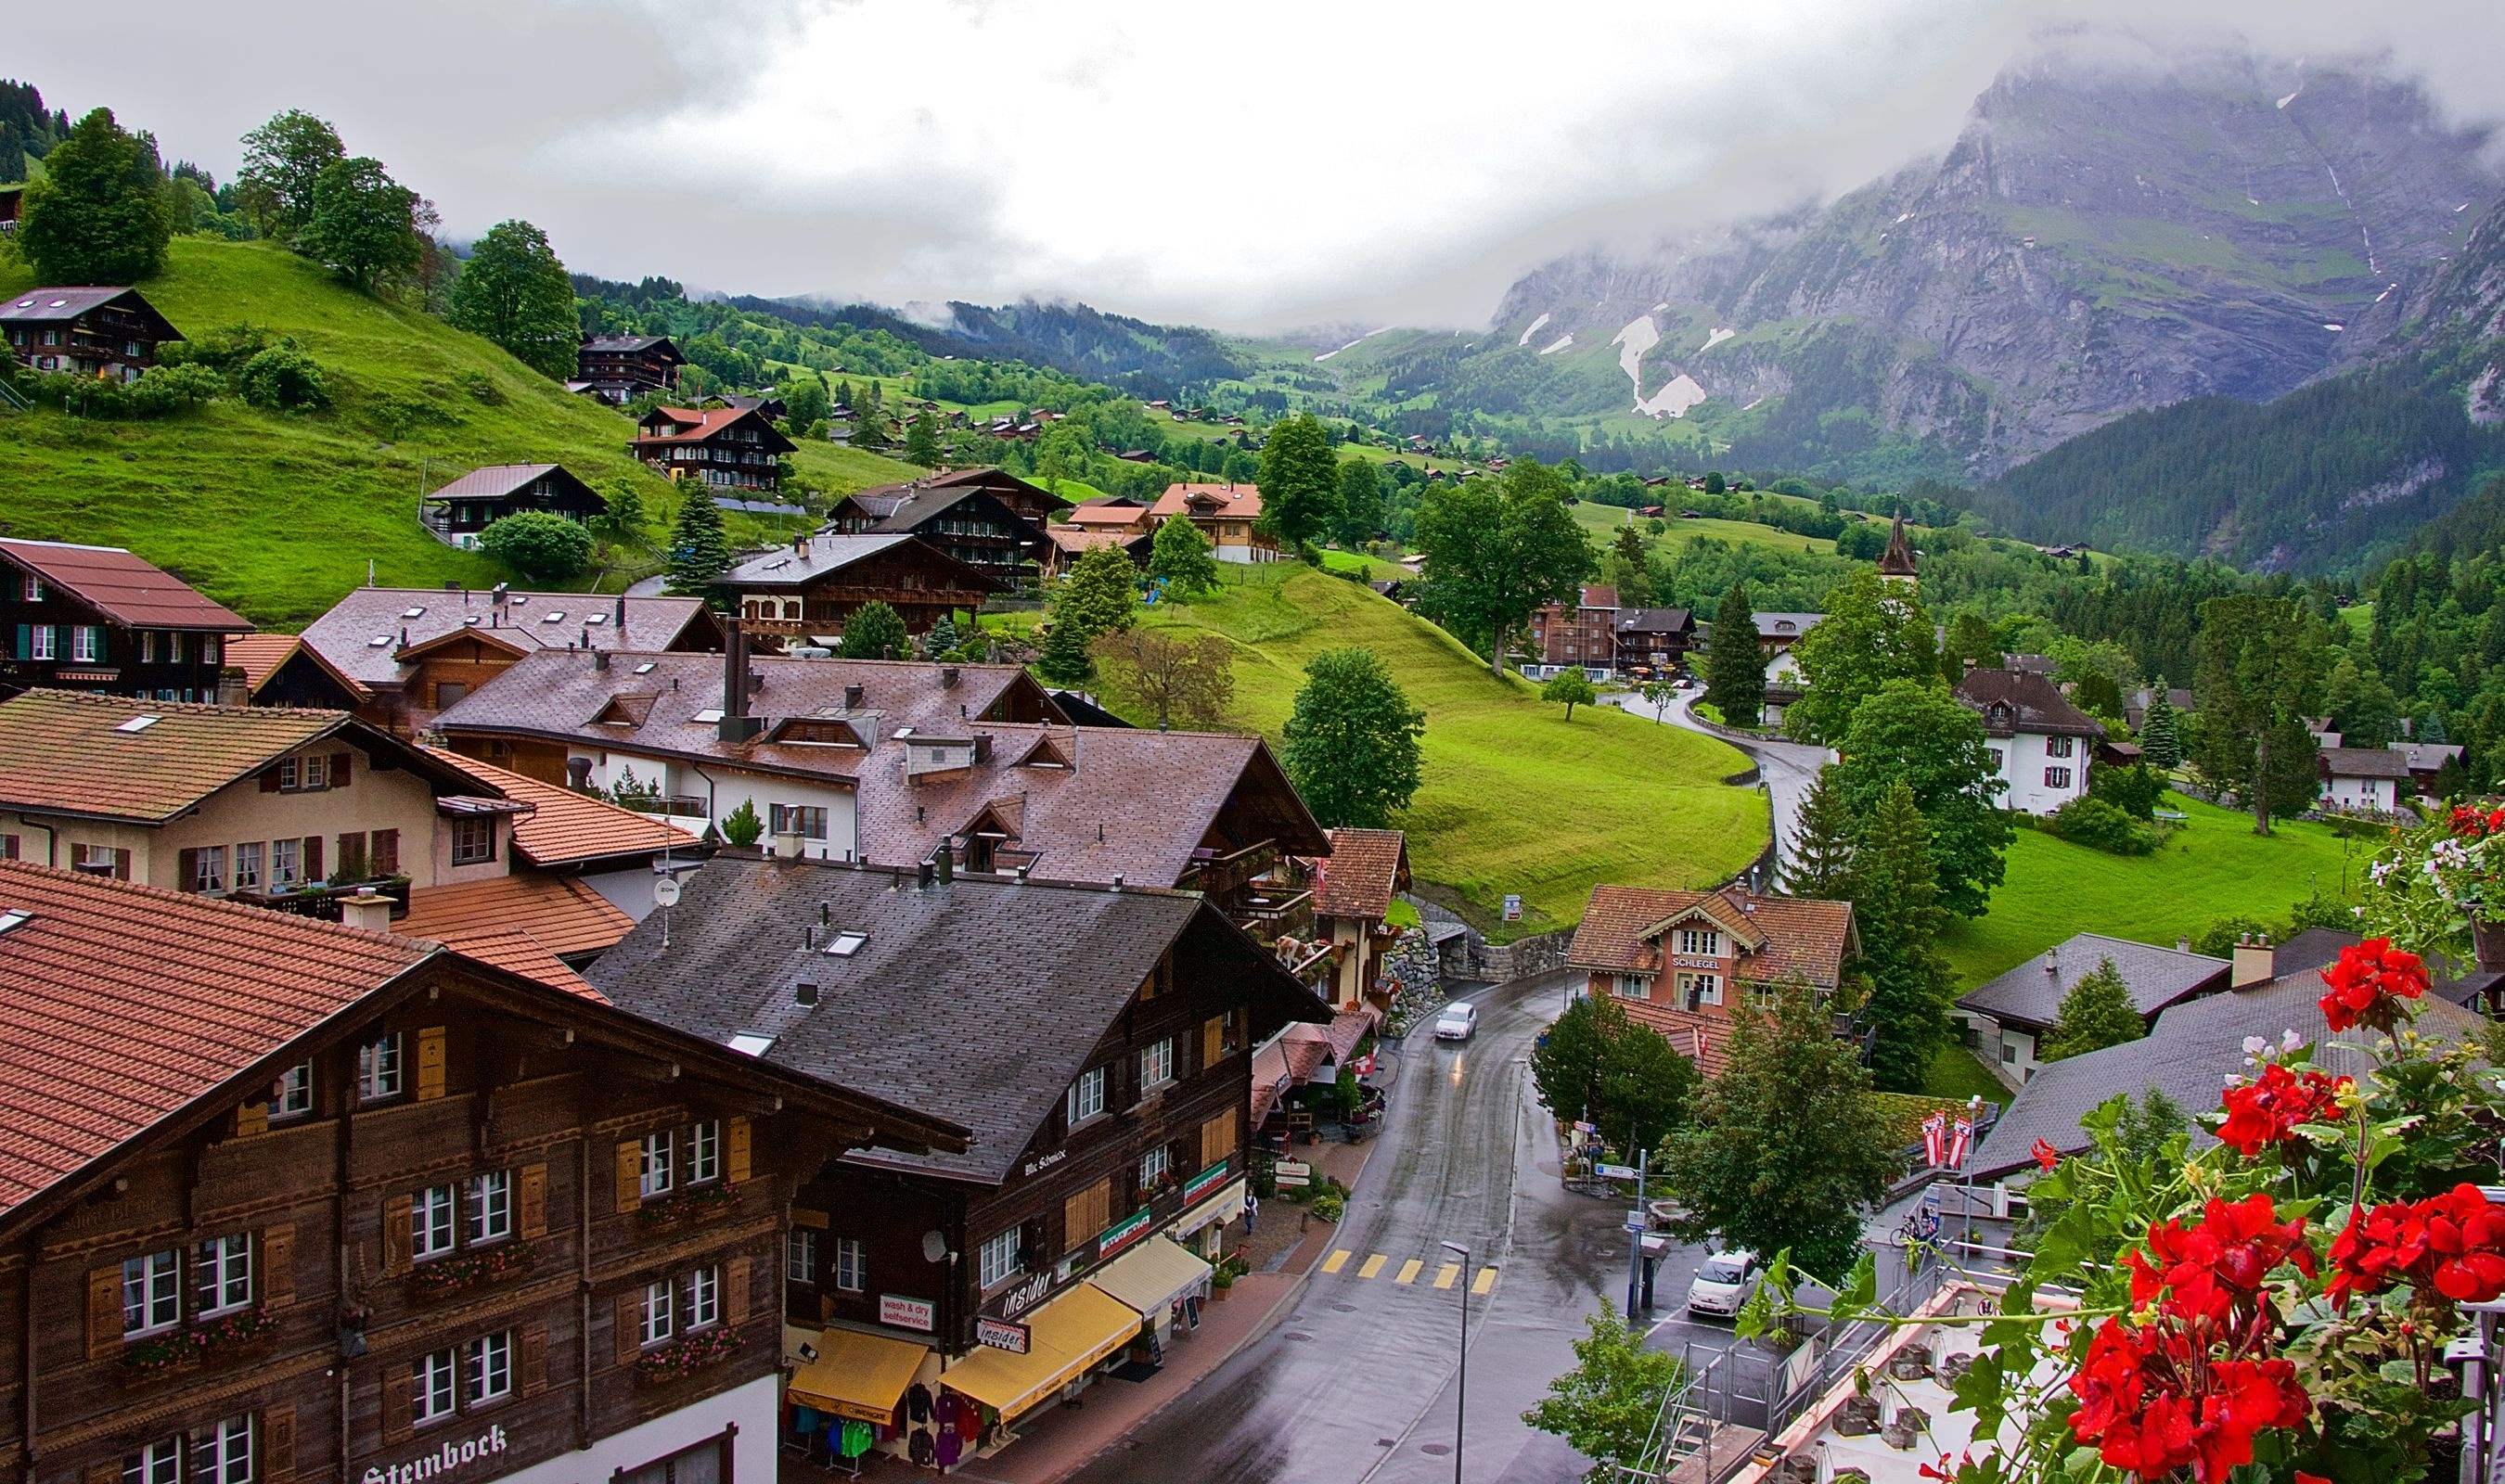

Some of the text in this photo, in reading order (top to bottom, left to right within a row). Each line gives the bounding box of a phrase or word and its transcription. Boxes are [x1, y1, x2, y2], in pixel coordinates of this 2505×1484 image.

[1672, 958, 1720, 969] SCHLEGEL
[1003, 1272, 1052, 1318] insider
[883, 1300, 929, 1317] wash & dry
[883, 1311, 930, 1326] selfservice
[981, 1326, 1021, 1345] insider
[362, 1424, 507, 1484] Steinbock
